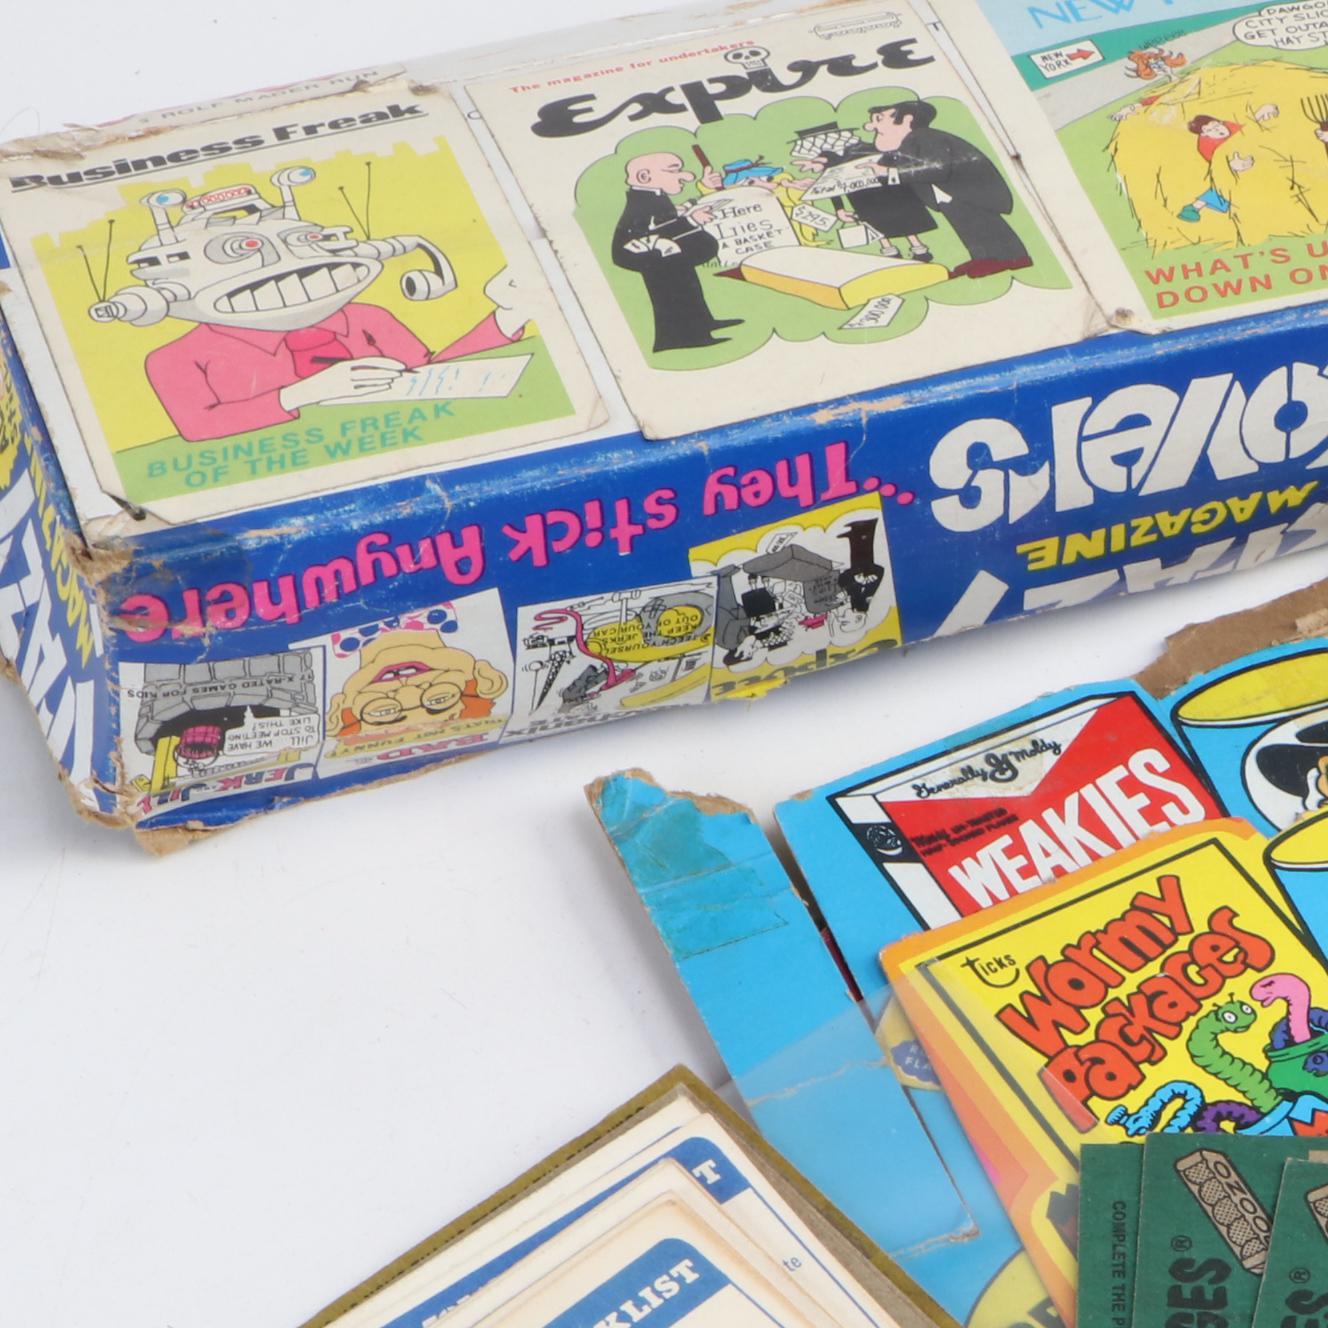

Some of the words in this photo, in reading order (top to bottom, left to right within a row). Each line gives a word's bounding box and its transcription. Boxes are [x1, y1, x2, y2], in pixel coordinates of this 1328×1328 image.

[510, 82, 540, 95] The
[547, 66, 626, 88] magazine
[629, 59, 655, 72] for
[659, 38, 756, 66] undertakers
[10, 132, 266, 189] Business
[272, 103, 423, 142] Freak
[1144, 248, 1293, 286] WHAT'S
[1156, 273, 1274, 311] DOWN
[146, 427, 325, 479] BUSINESS
[339, 400, 456, 438] FREAK
[184, 464, 229, 489] OF
[242, 447, 310, 476] THE
[324, 425, 424, 460] WEEK
[505, 487, 680, 569] stick
[1016, 480, 1319, 571] MAGAZINE
[119, 522, 488, 644] Anywhere
[947, 747, 1207, 910] WEAKIES
